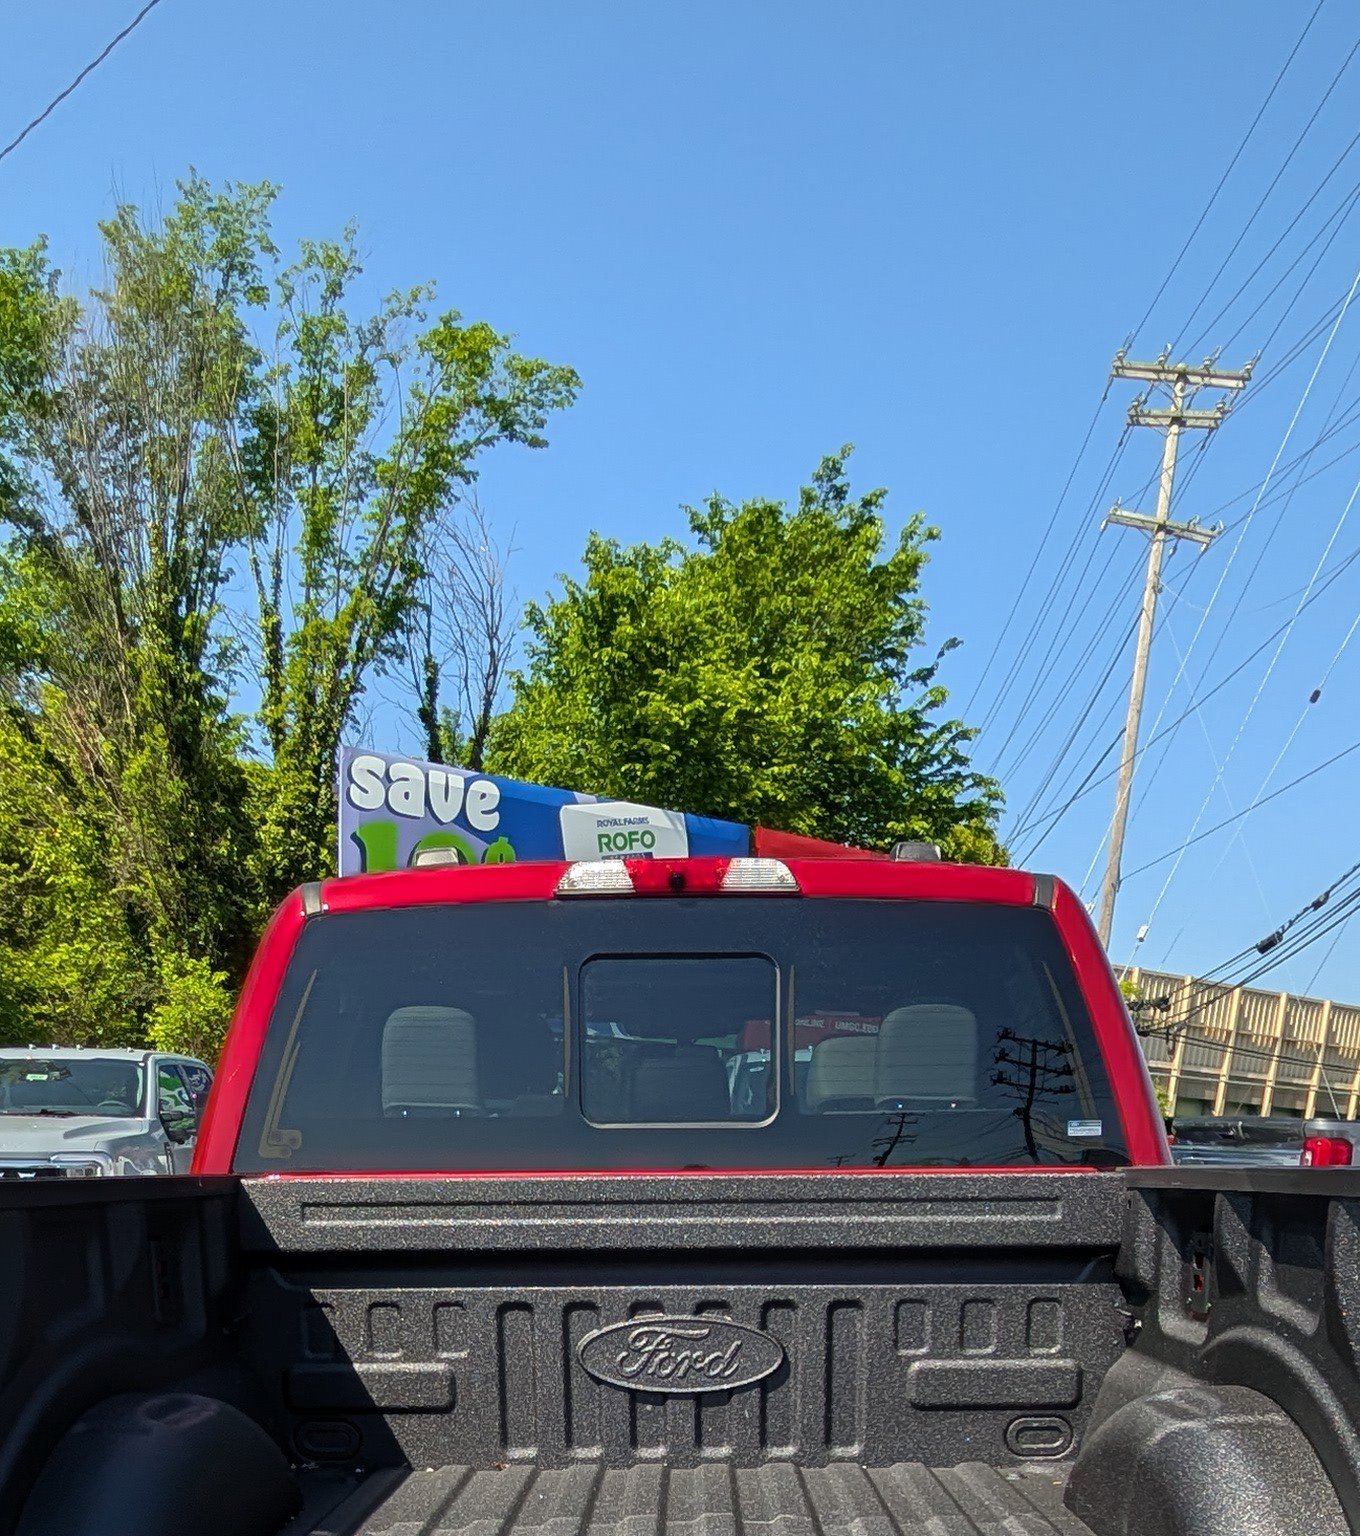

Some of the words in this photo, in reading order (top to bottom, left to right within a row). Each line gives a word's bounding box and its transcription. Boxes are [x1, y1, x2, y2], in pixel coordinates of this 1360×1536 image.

[348, 755, 500, 832] save
[597, 829, 656, 853] ROFO
[616, 1325, 742, 1378] Ford
